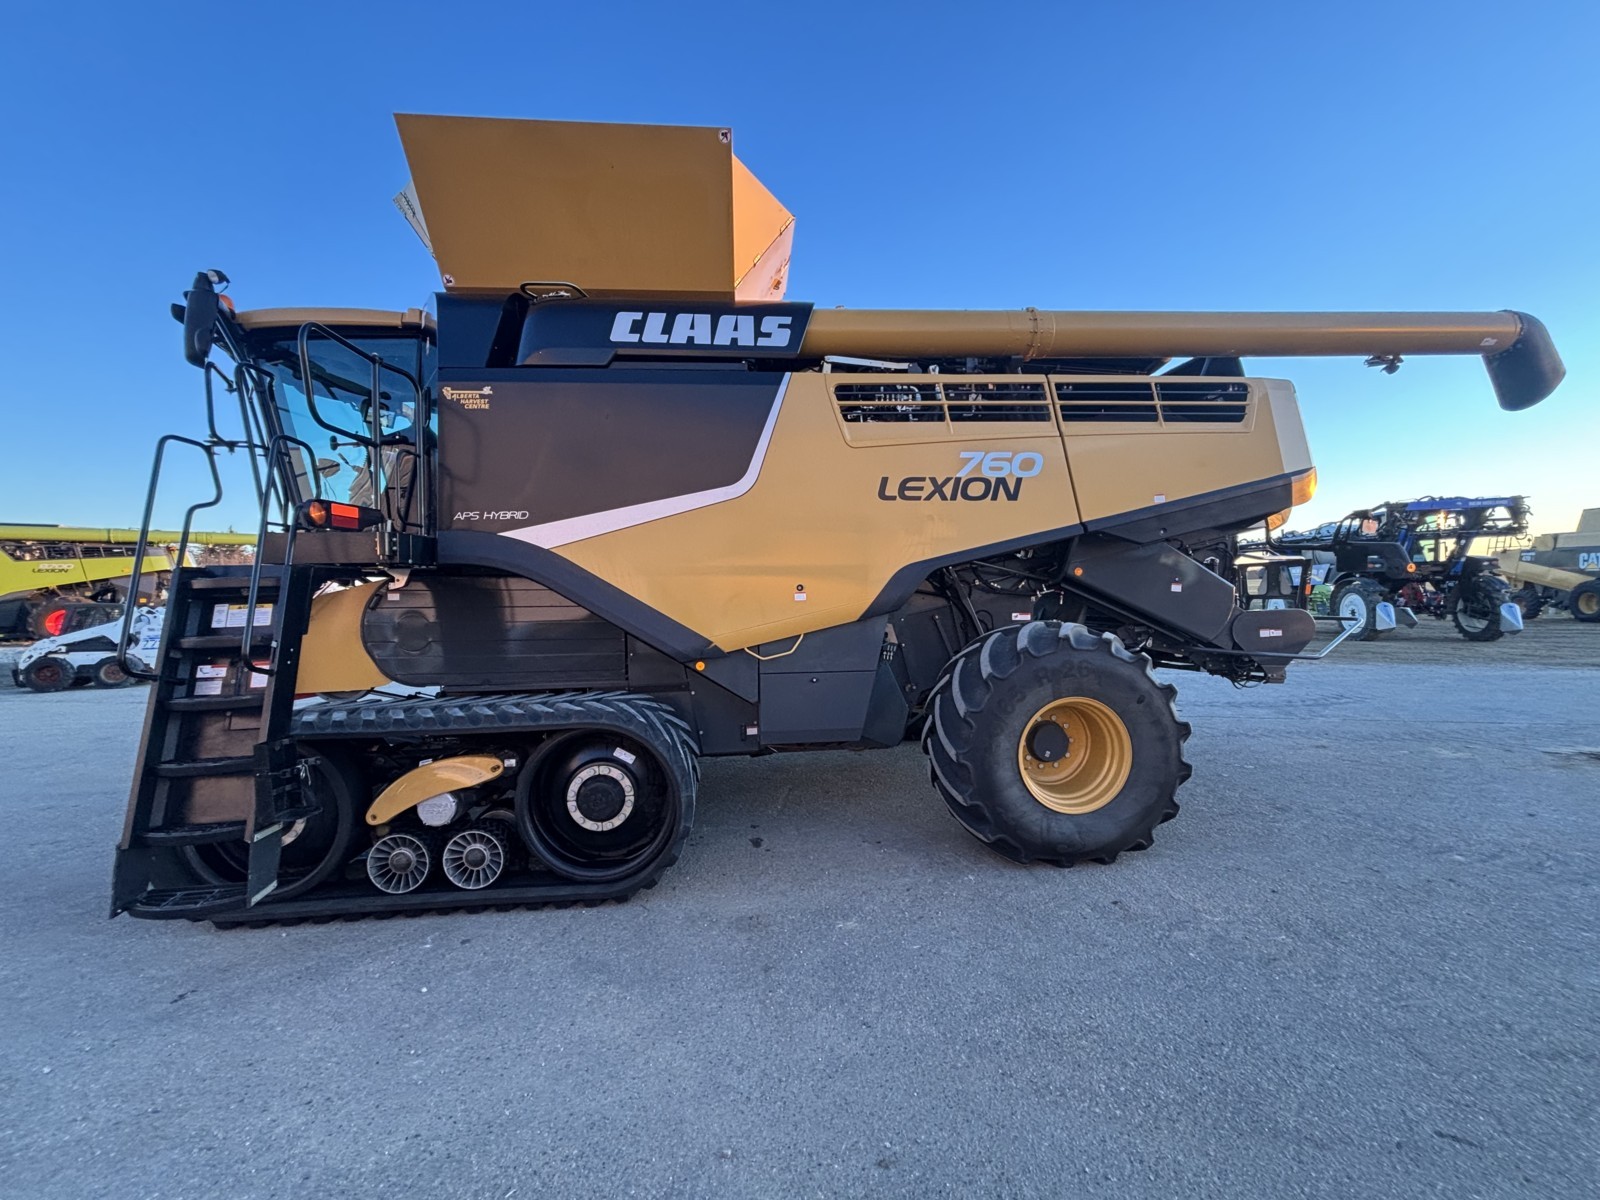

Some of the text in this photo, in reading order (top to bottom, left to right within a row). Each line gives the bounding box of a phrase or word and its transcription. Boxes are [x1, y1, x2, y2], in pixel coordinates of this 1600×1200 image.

[609, 311, 793, 347] CLAAS
[451, 393, 480, 401] ALBERTA
[955, 451, 1044, 478] 760
[877, 476, 1023, 502] LEXION
[453, 510, 529, 521] APS HYBRID
